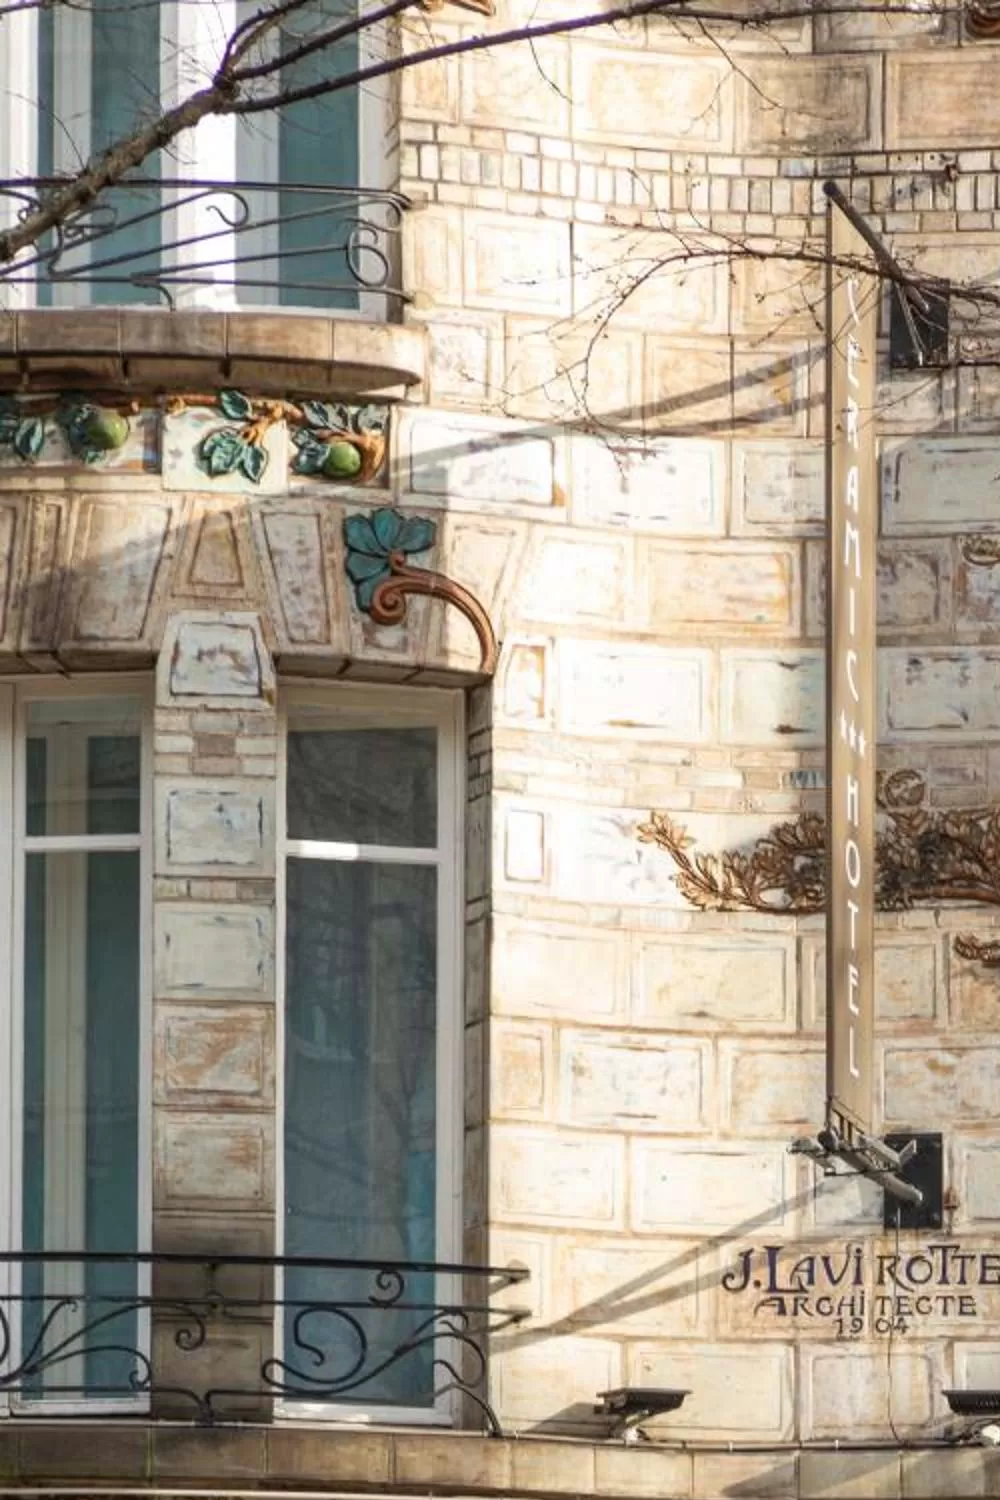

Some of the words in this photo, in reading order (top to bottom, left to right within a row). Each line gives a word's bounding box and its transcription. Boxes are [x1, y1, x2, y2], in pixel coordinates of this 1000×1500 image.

[844, 275, 861, 703] CERAMIC
[844, 773, 861, 1080] HOTEL
[753, 1289, 978, 1317] ARCHITECTE
[835, 1317, 910, 1335] 1904
